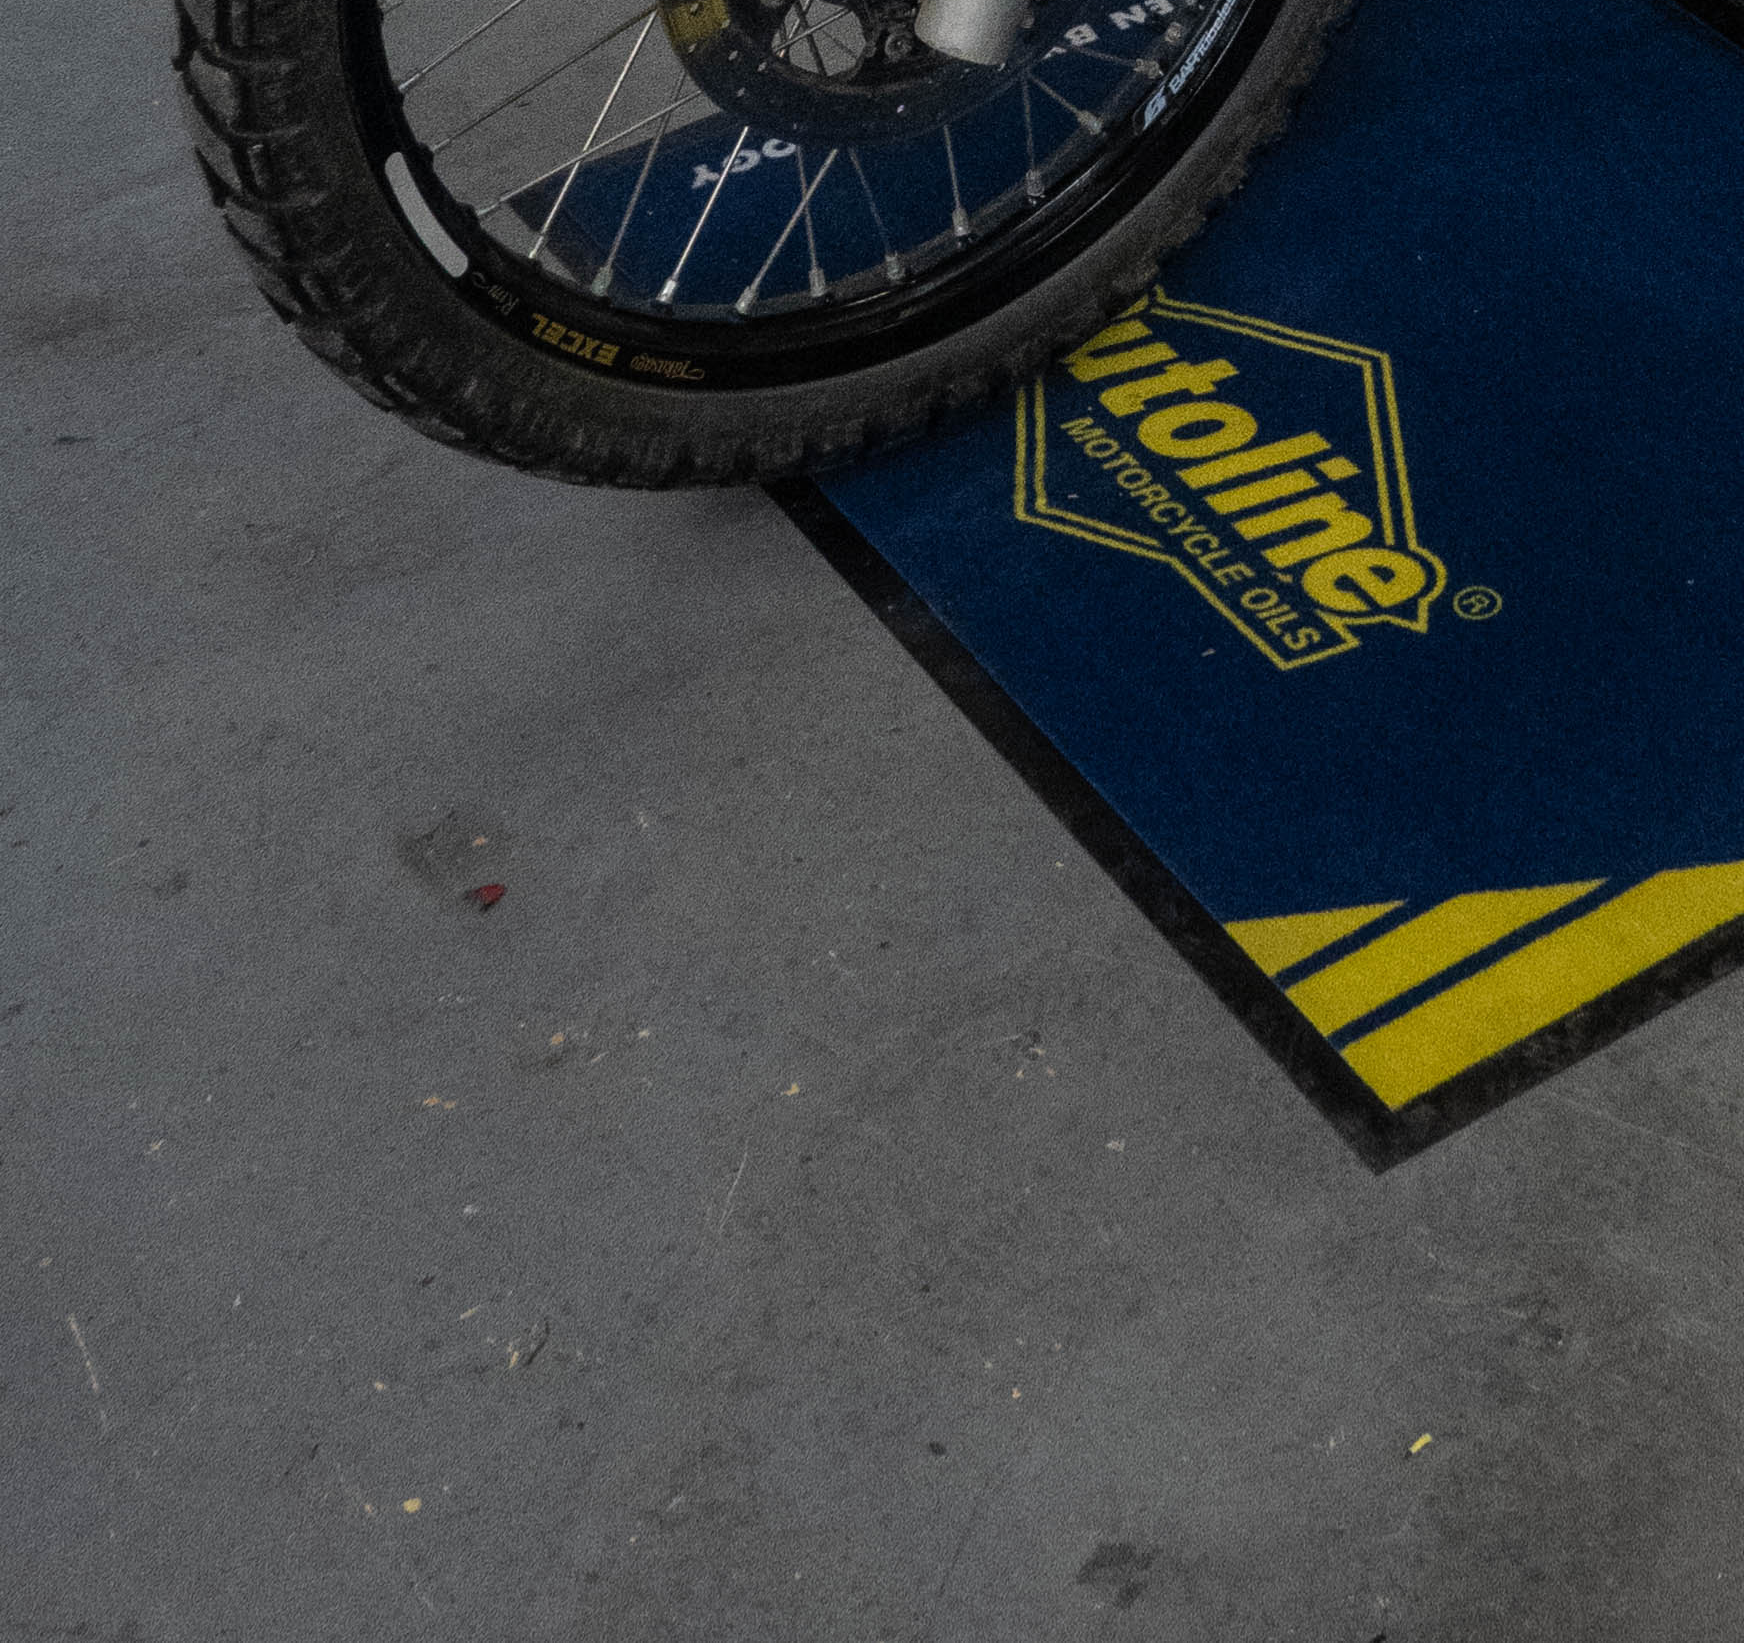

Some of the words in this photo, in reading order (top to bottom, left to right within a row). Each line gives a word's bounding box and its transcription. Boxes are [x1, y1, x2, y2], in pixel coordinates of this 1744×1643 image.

[530, 311, 622, 369] EXCEL
[1059, 318, 1427, 613] utoline
[1060, 415, 1251, 587] MOTORCYCLE
[1240, 585, 1323, 652] OILS
